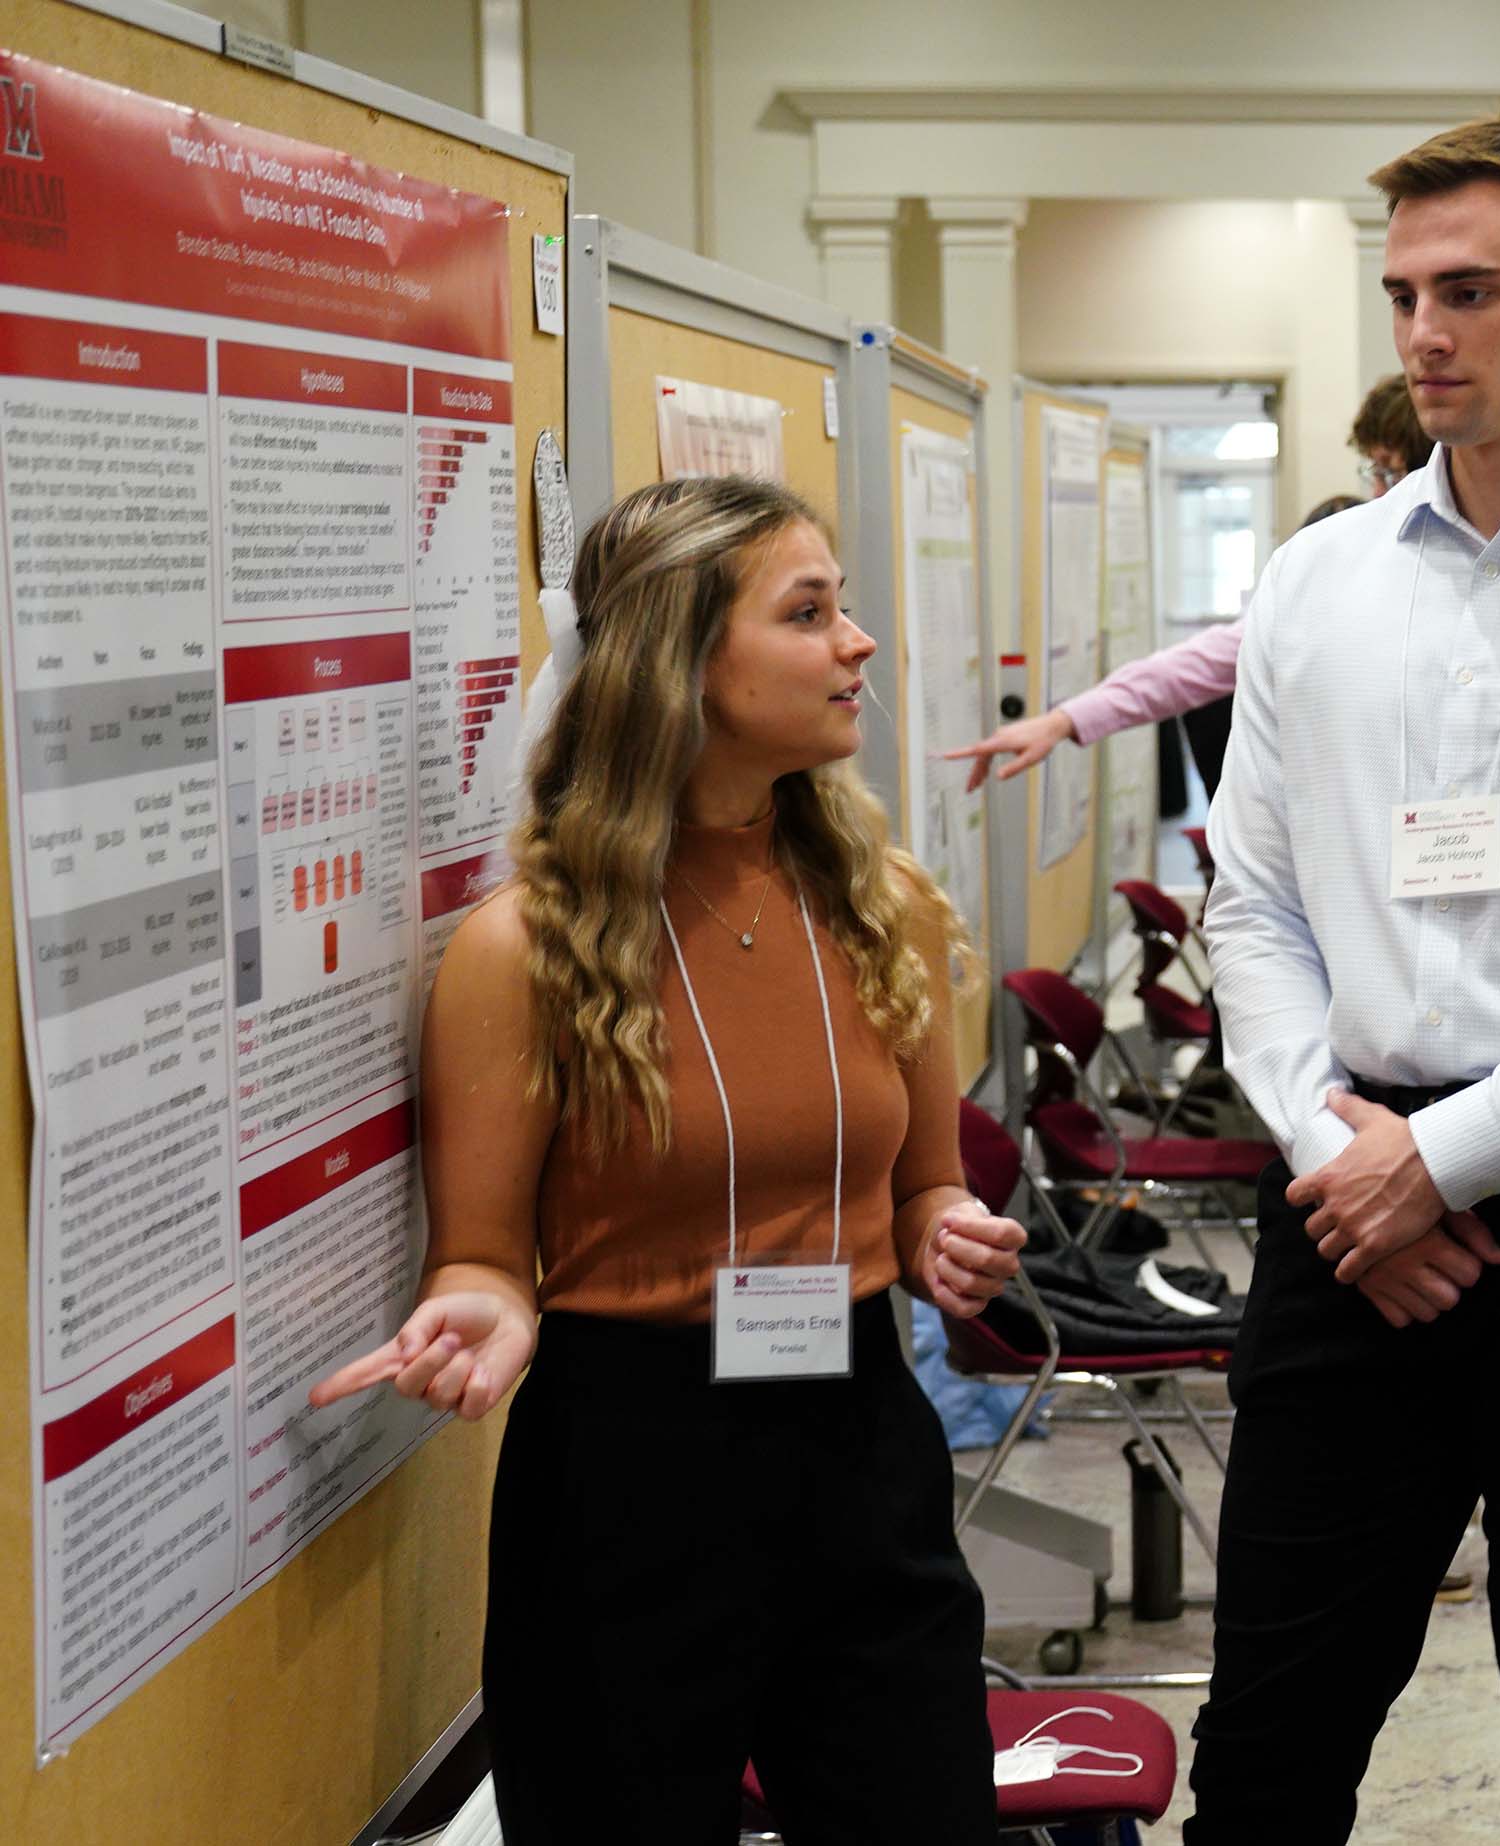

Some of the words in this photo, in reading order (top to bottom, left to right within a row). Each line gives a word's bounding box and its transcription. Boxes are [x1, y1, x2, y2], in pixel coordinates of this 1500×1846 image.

[167, 128, 207, 166] Impact
[206, 141, 219, 168] of
[218, 143, 251, 182] Turf,
[296, 167, 318, 193] and
[240, 187, 282, 223] Injuries
[292, 204, 306, 228] an
[305, 203, 327, 233] NFL
[79, 341, 141, 371] Introduction
[313, 652, 343, 679] Process
[1433, 832, 1470, 848] Jacob
[1416, 853, 1446, 865] Jacob
[736, 1315, 806, 1333] Samantha
[124, 1373, 174, 1419] Objectives
